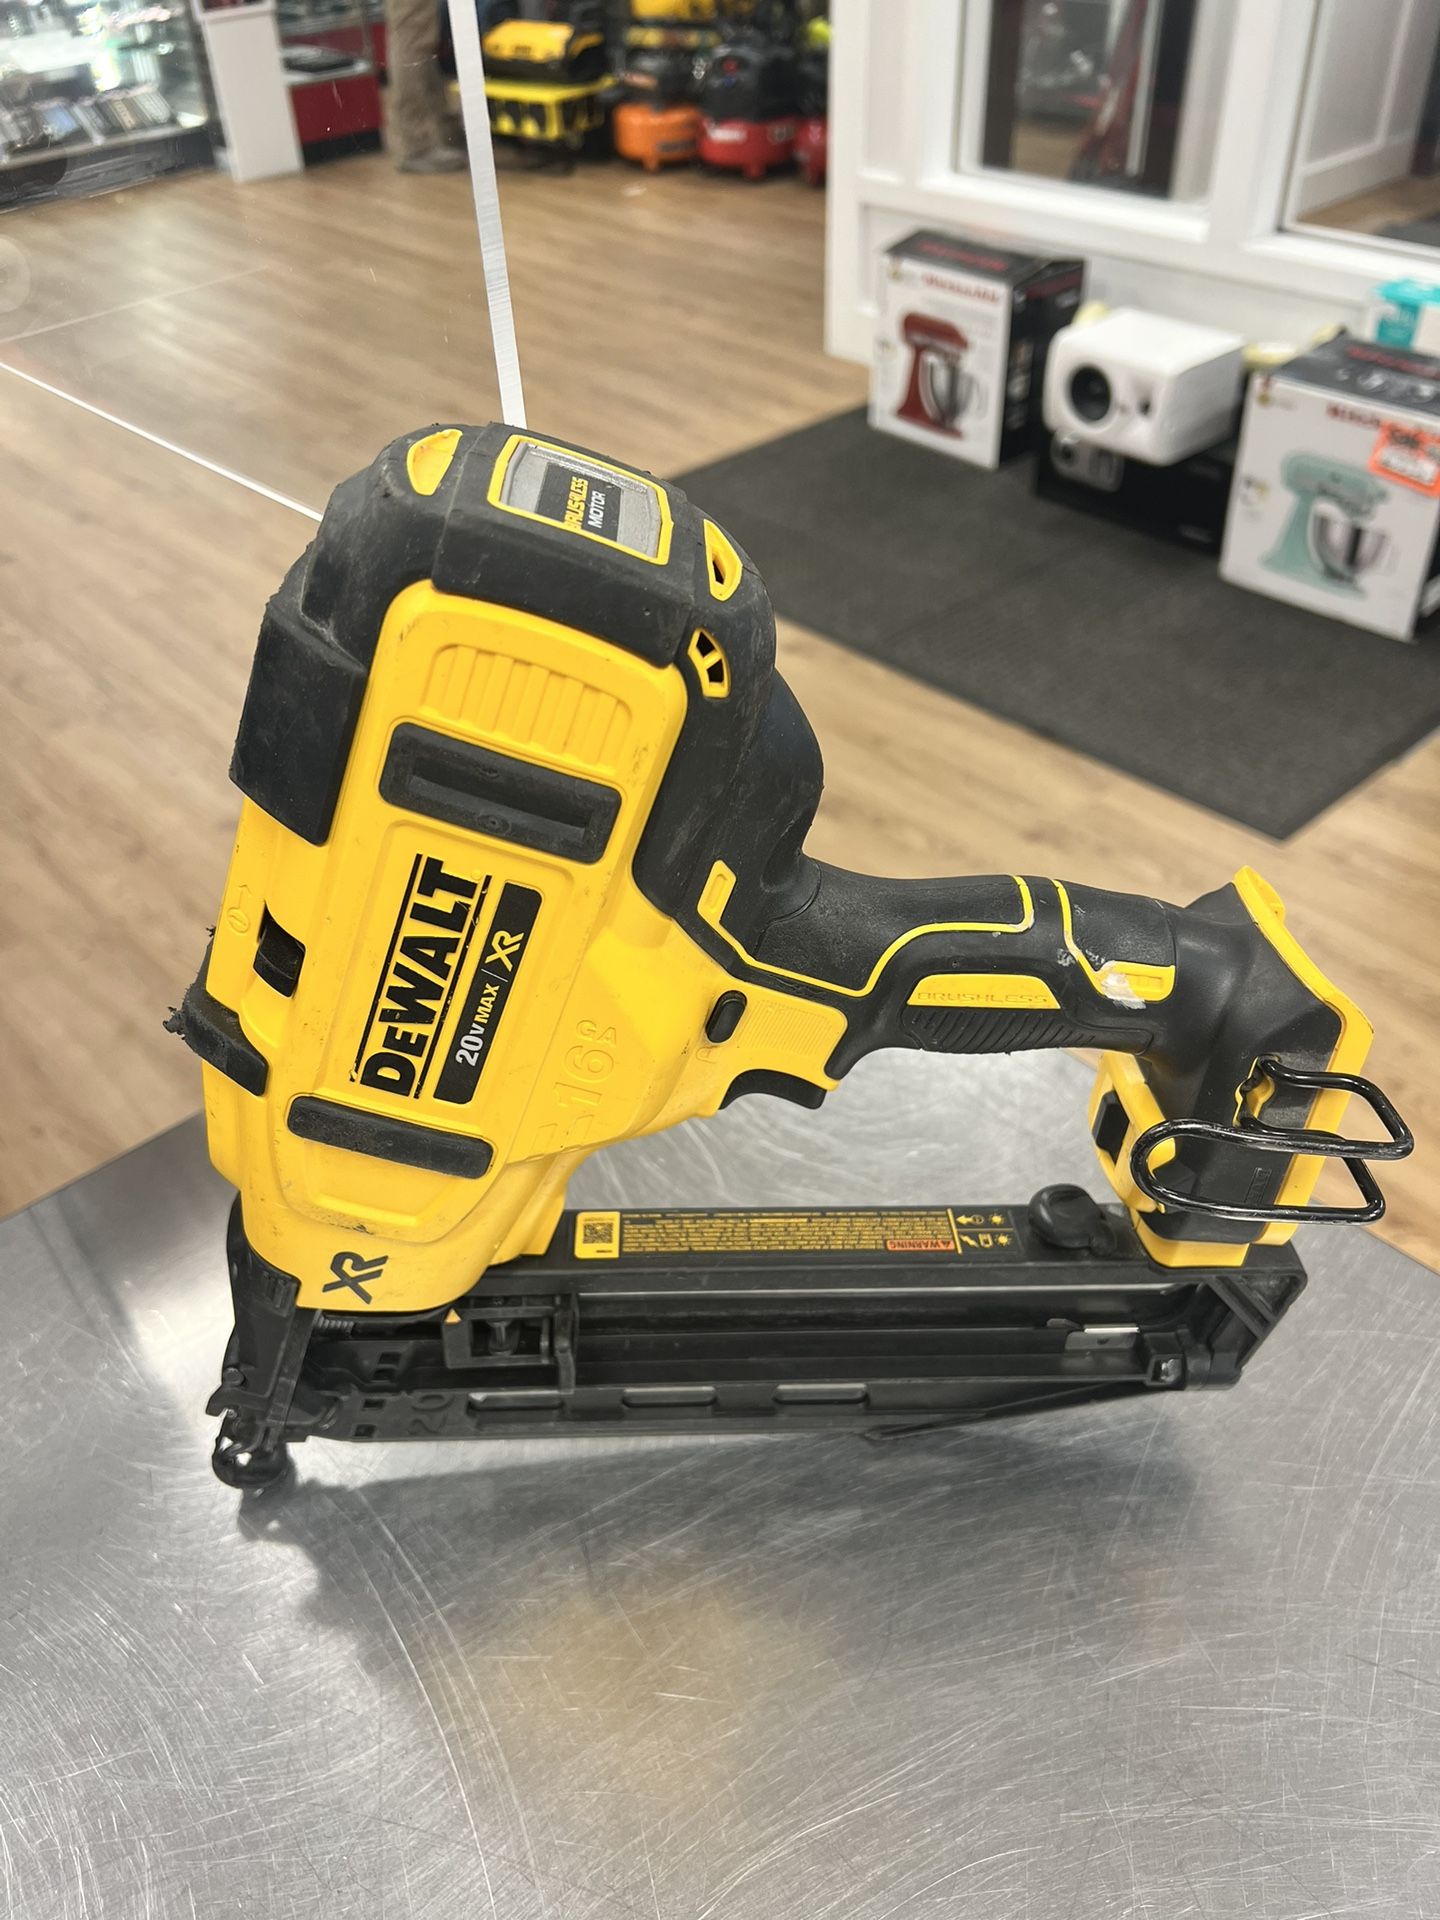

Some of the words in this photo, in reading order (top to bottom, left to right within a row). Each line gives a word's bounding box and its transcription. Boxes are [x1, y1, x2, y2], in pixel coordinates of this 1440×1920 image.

[587, 490, 606, 528] MOTOR
[485, 930, 525, 972] XR
[360, 856, 478, 1097] DEWALT
[480, 983, 500, 1024] MAX
[917, 992, 1048, 1004] BRUSHLESS
[889, 1239, 942, 1249] WARNING
[322, 1251, 389, 1305] XR
